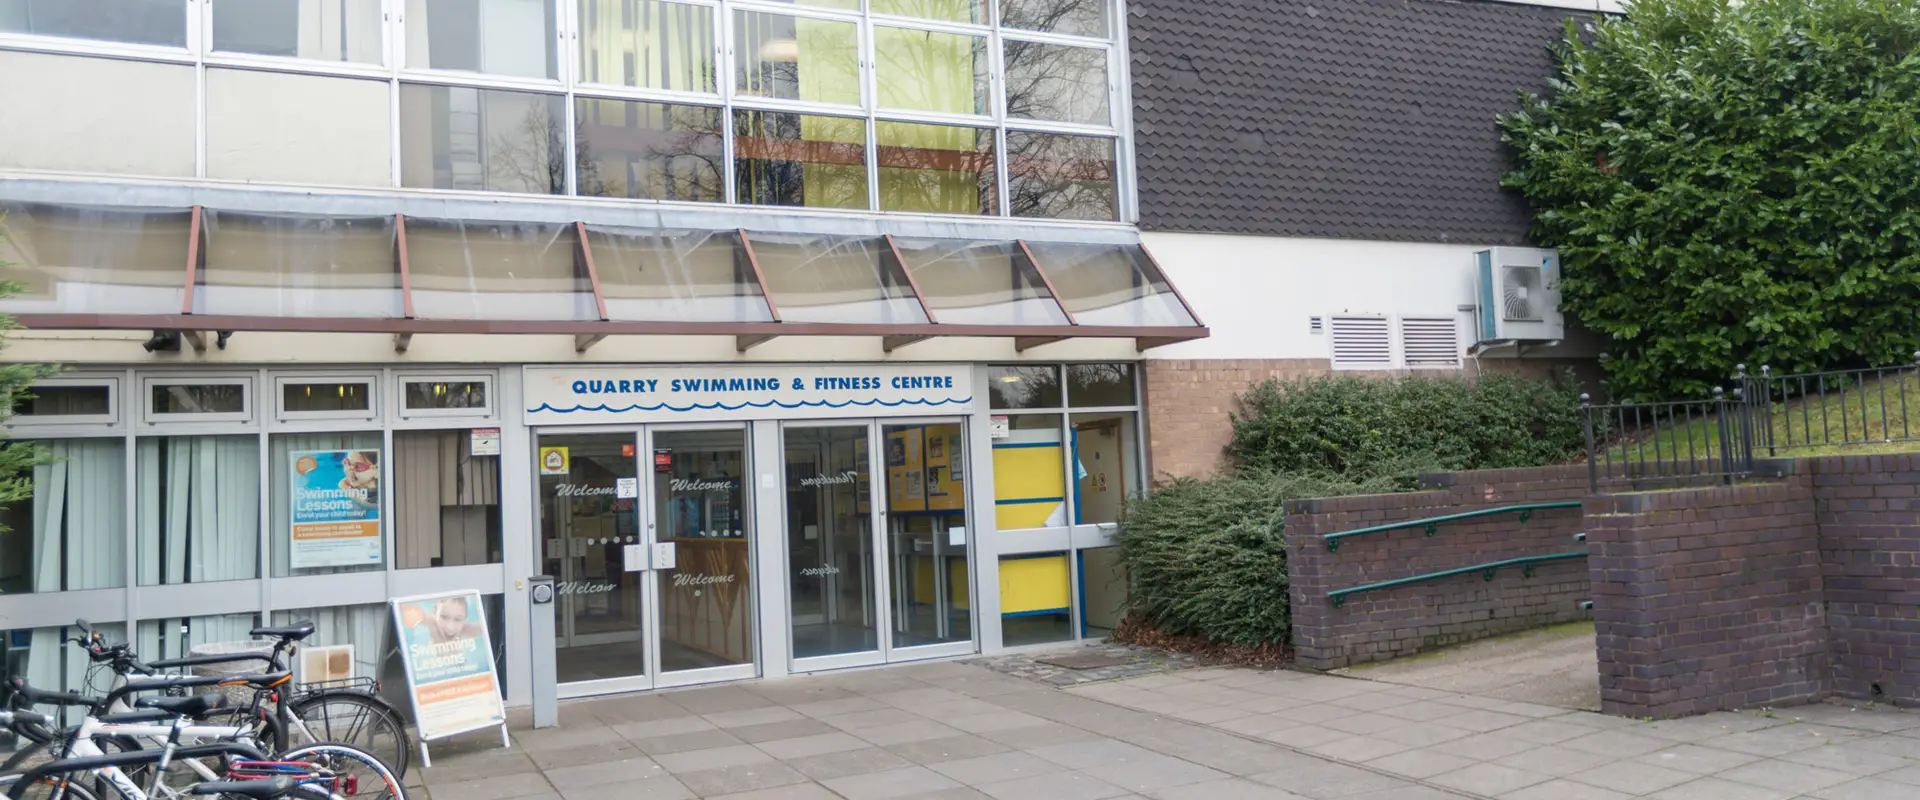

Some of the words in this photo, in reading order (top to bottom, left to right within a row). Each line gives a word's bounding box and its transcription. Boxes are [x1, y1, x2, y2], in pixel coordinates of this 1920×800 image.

[572, 379, 658, 394] QUARRY
[671, 377, 780, 392] SWIMMING
[792, 377, 805, 390] &
[815, 376, 881, 390] FITNESS
[891, 376, 953, 389] CENTRE
[669, 478, 731, 491] Welcome
[297, 486, 369, 500] Swimming
[297, 499, 353, 512] Lessons
[672, 572, 735, 587] Welcome
[410, 636, 476, 657] Swimming
[413, 652, 465, 672] Lessons
